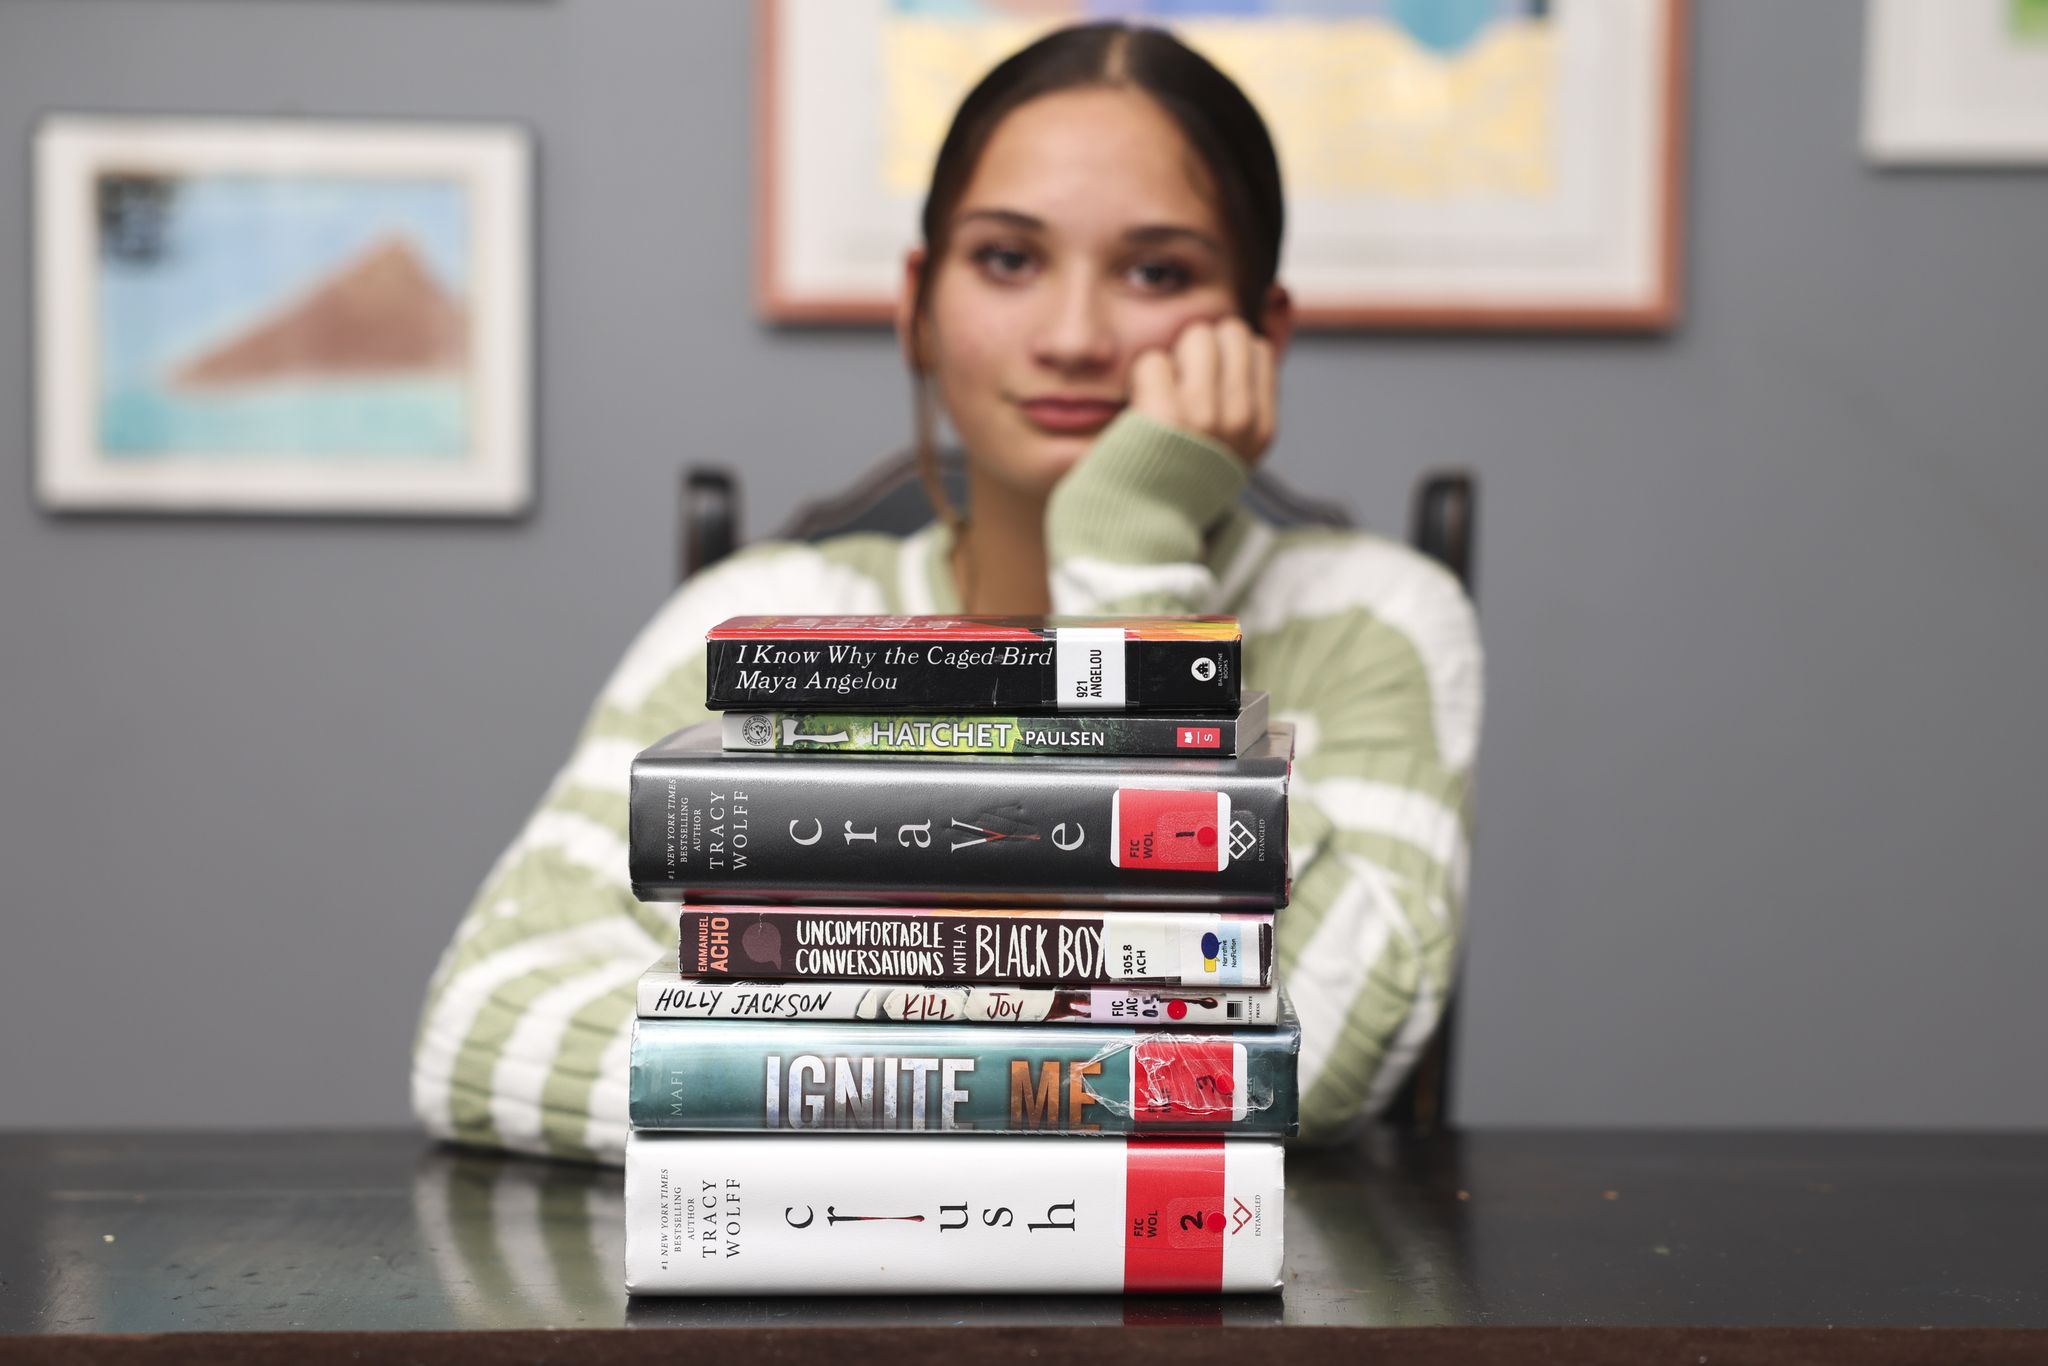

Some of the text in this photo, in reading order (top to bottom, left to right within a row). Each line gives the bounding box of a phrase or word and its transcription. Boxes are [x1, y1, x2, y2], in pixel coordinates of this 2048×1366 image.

[736, 645, 1054, 669] I Know Why the Caged Bird
[1090, 649, 1102, 698] ANGELOU
[736, 671, 897, 694] Maya Angelou
[1076, 680, 1088, 698] 921
[872, 722, 1012, 748] HATCHET
[1025, 731, 1105, 746] PAULSEN
[668, 778, 677, 880] #1 NEW YORK TIMES
[680, 797, 689, 863] BESTSELLING
[693, 809, 701, 851] AUTHOR
[710, 791, 725, 869] TRACY
[733, 790, 749, 870] WOLFF
[1143, 831, 1154, 859] WOL
[1258, 819, 1266, 862] ENTANGLED
[1130, 839, 1140, 859] FIC
[698, 915, 708, 972] EMMANUEL
[710, 917, 729, 972] ACHO
[796, 920, 945, 948] UNCOMFORTABLE
[953, 924, 967, 974] WITH A
[975, 924, 1104, 979] BLACK BOY
[795, 948, 945, 976] CONVERSATIONS
[1123, 944, 1133, 975] 305.8
[1137, 950, 1147, 975] ACH
[654, 988, 832, 1018] HOLLY JACKSON
[902, 993, 955, 1021] KILL
[1112, 1000, 1124, 1017] FIC
[1126, 997, 1138, 1017] JAC
[670, 1070, 683, 1117] MAFI
[766, 1054, 1102, 1131] IGNITE ME
[661, 1168, 669, 1271] #1 NEW YORK TIMES
[674, 1186, 682, 1253] BESTSELLING
[687, 1198, 695, 1240] AUTHOR
[702, 1180, 717, 1258] TRACY
[726, 1179, 741, 1259] WOLFF
[1134, 1218, 1145, 1237] FIC
[1147, 1210, 1159, 1238] WOL
[1180, 1211, 1203, 1232] 2
